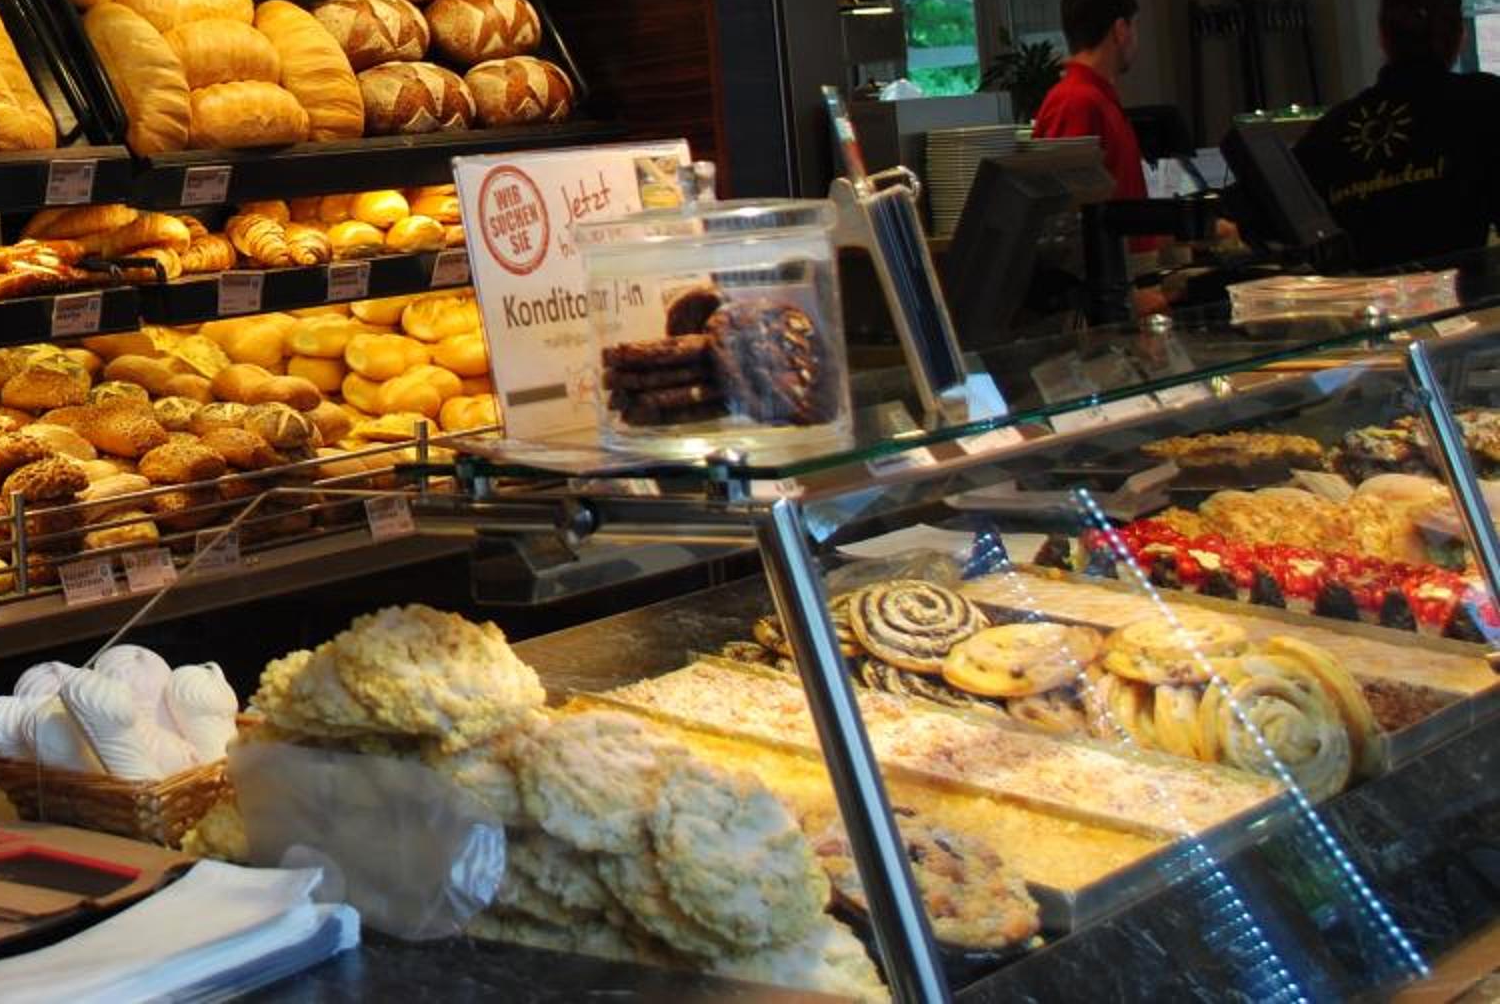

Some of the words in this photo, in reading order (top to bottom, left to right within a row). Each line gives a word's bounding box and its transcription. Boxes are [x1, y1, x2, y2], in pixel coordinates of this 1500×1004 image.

[492, 184, 523, 210] WIR
[559, 171, 612, 230] Jetzt
[488, 203, 540, 239] SUCHEN
[508, 230, 534, 255] SIE
